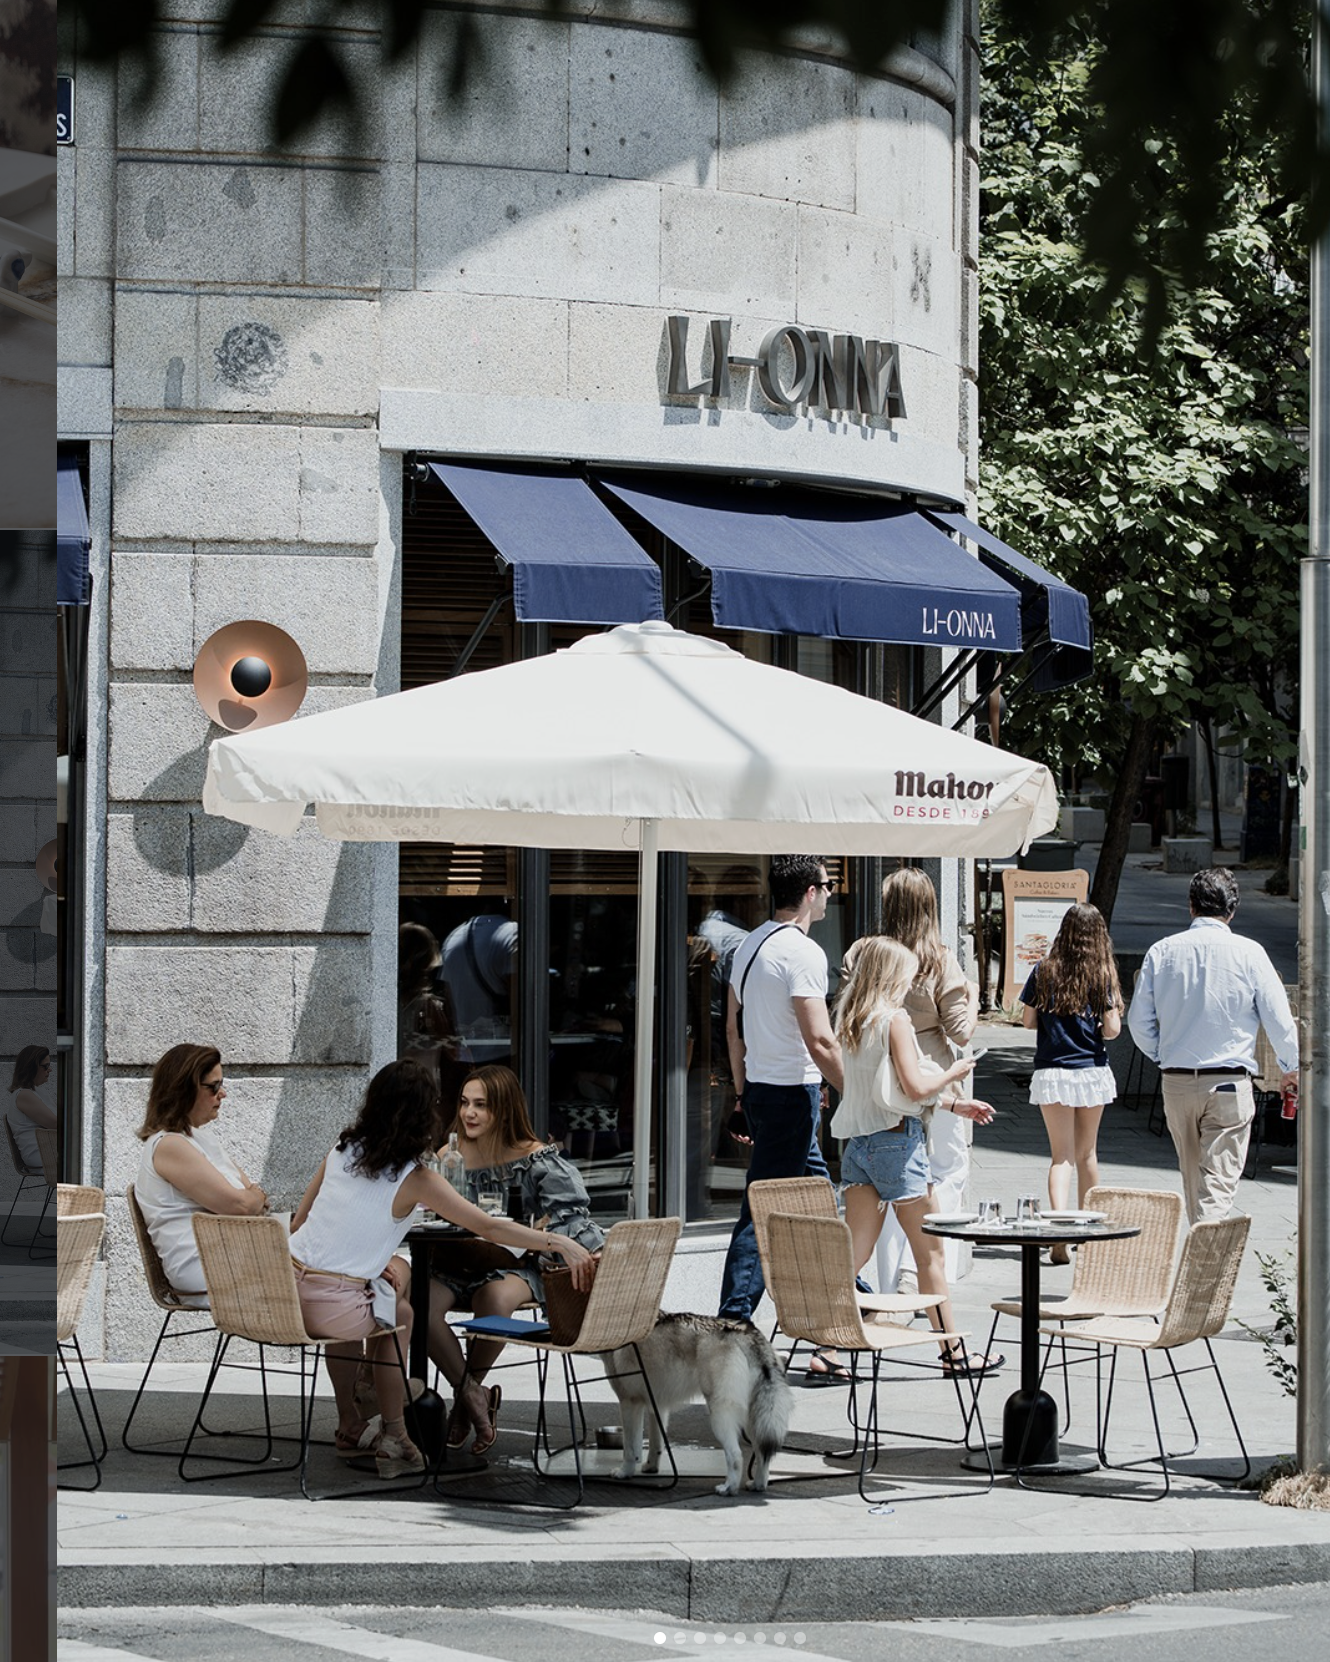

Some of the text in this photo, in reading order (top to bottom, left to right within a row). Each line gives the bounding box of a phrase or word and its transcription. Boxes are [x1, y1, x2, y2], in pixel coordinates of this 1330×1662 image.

[668, 316, 907, 419] LI-ONNA
[922, 607, 996, 639] LI-ONNA
[894, 805, 990, 819] DESDE 189
[1013, 881, 1077, 890] SANTAGLORIA
